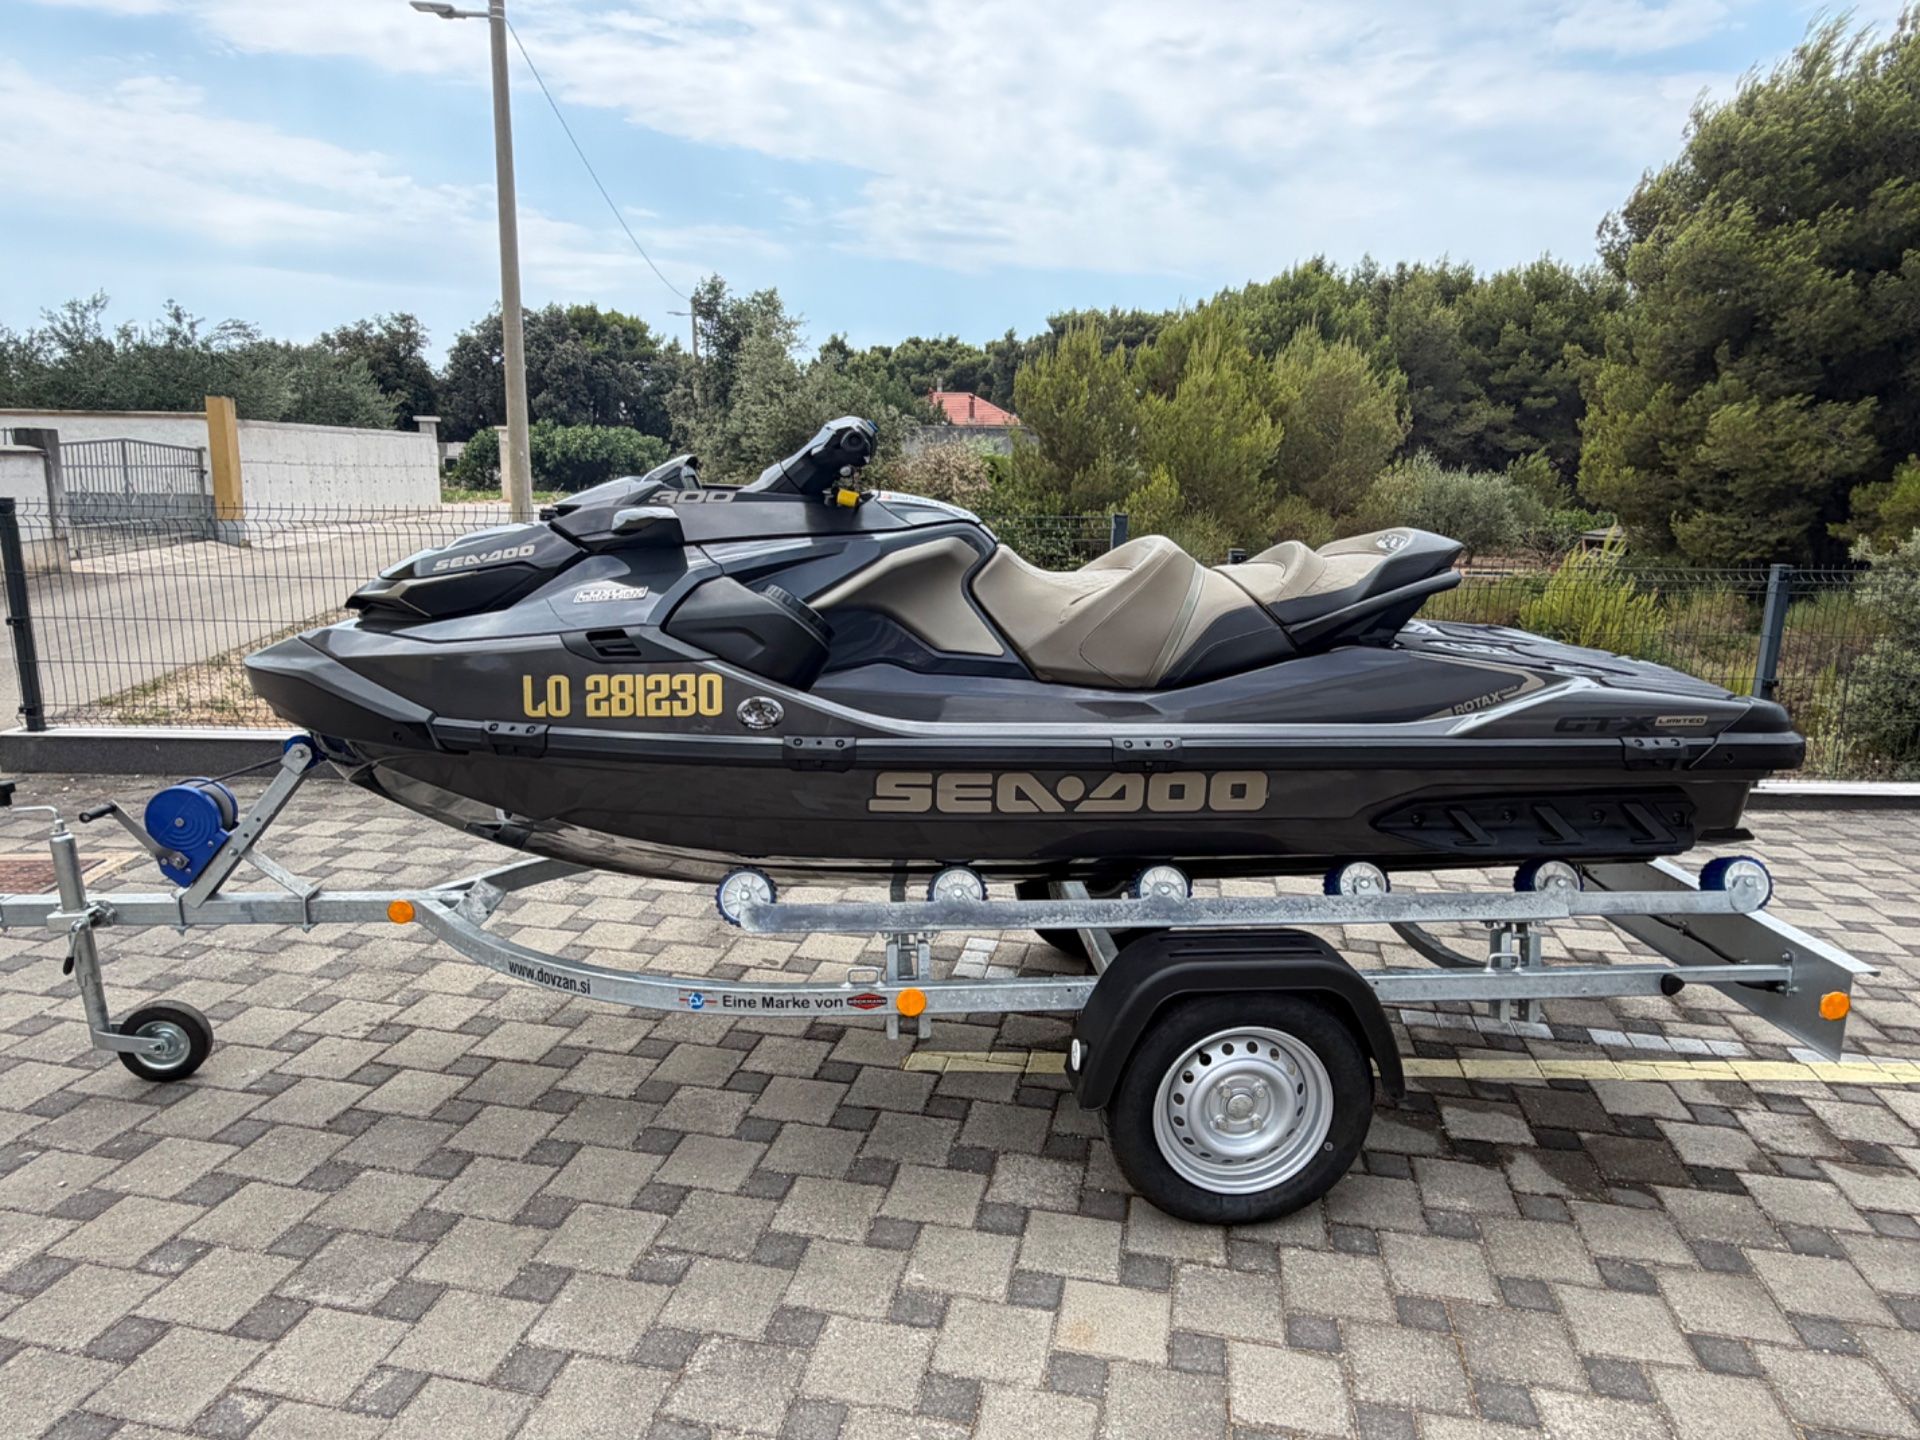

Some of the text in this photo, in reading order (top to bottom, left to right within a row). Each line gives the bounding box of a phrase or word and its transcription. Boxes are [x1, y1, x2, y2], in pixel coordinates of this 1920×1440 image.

[648, 490, 737, 504] 300
[523, 673, 723, 718] LO 281230
[1454, 691, 1502, 715] ROTAX
[1554, 716, 1706, 733] GTX LIMITED
[508, 961, 591, 995] www.dovzan.si
[722, 995, 757, 1008] Eine
[761, 996, 810, 1009] Marke
[814, 997, 843, 1008] von
